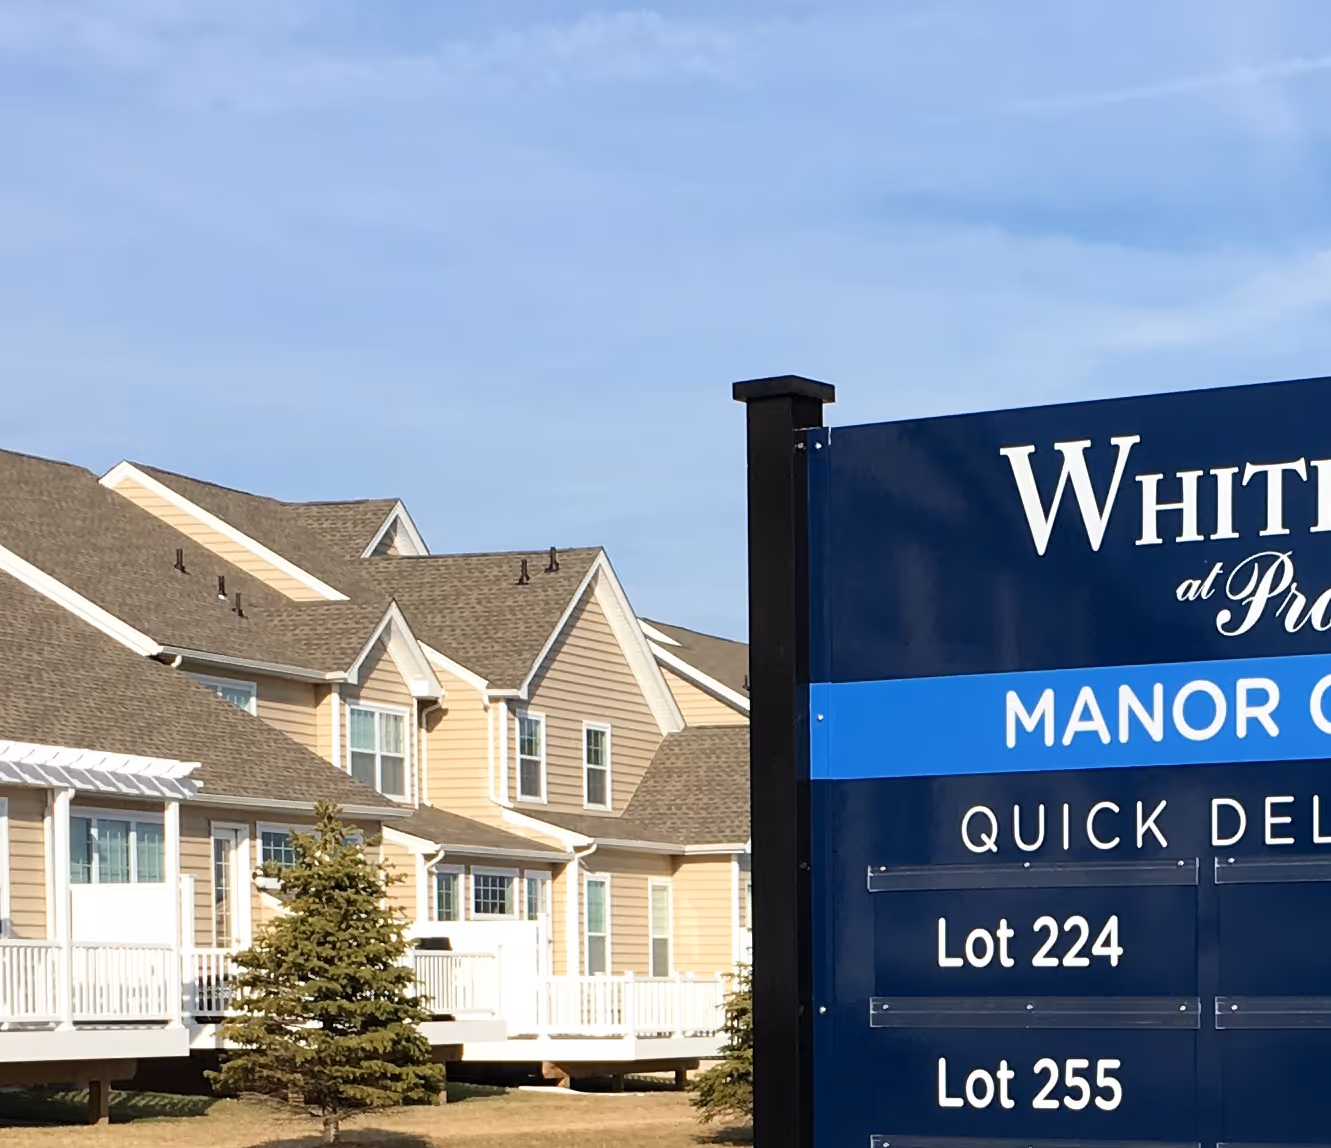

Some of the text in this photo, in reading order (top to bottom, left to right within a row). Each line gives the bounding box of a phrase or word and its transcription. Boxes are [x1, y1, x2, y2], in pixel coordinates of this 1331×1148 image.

[1176, 562, 1224, 601] at
[1006, 678, 1280, 749] MANOR
[961, 800, 1169, 853] QUICK
[937, 914, 1124, 968] Lot 224
[937, 1057, 1123, 1111] Lot 255
